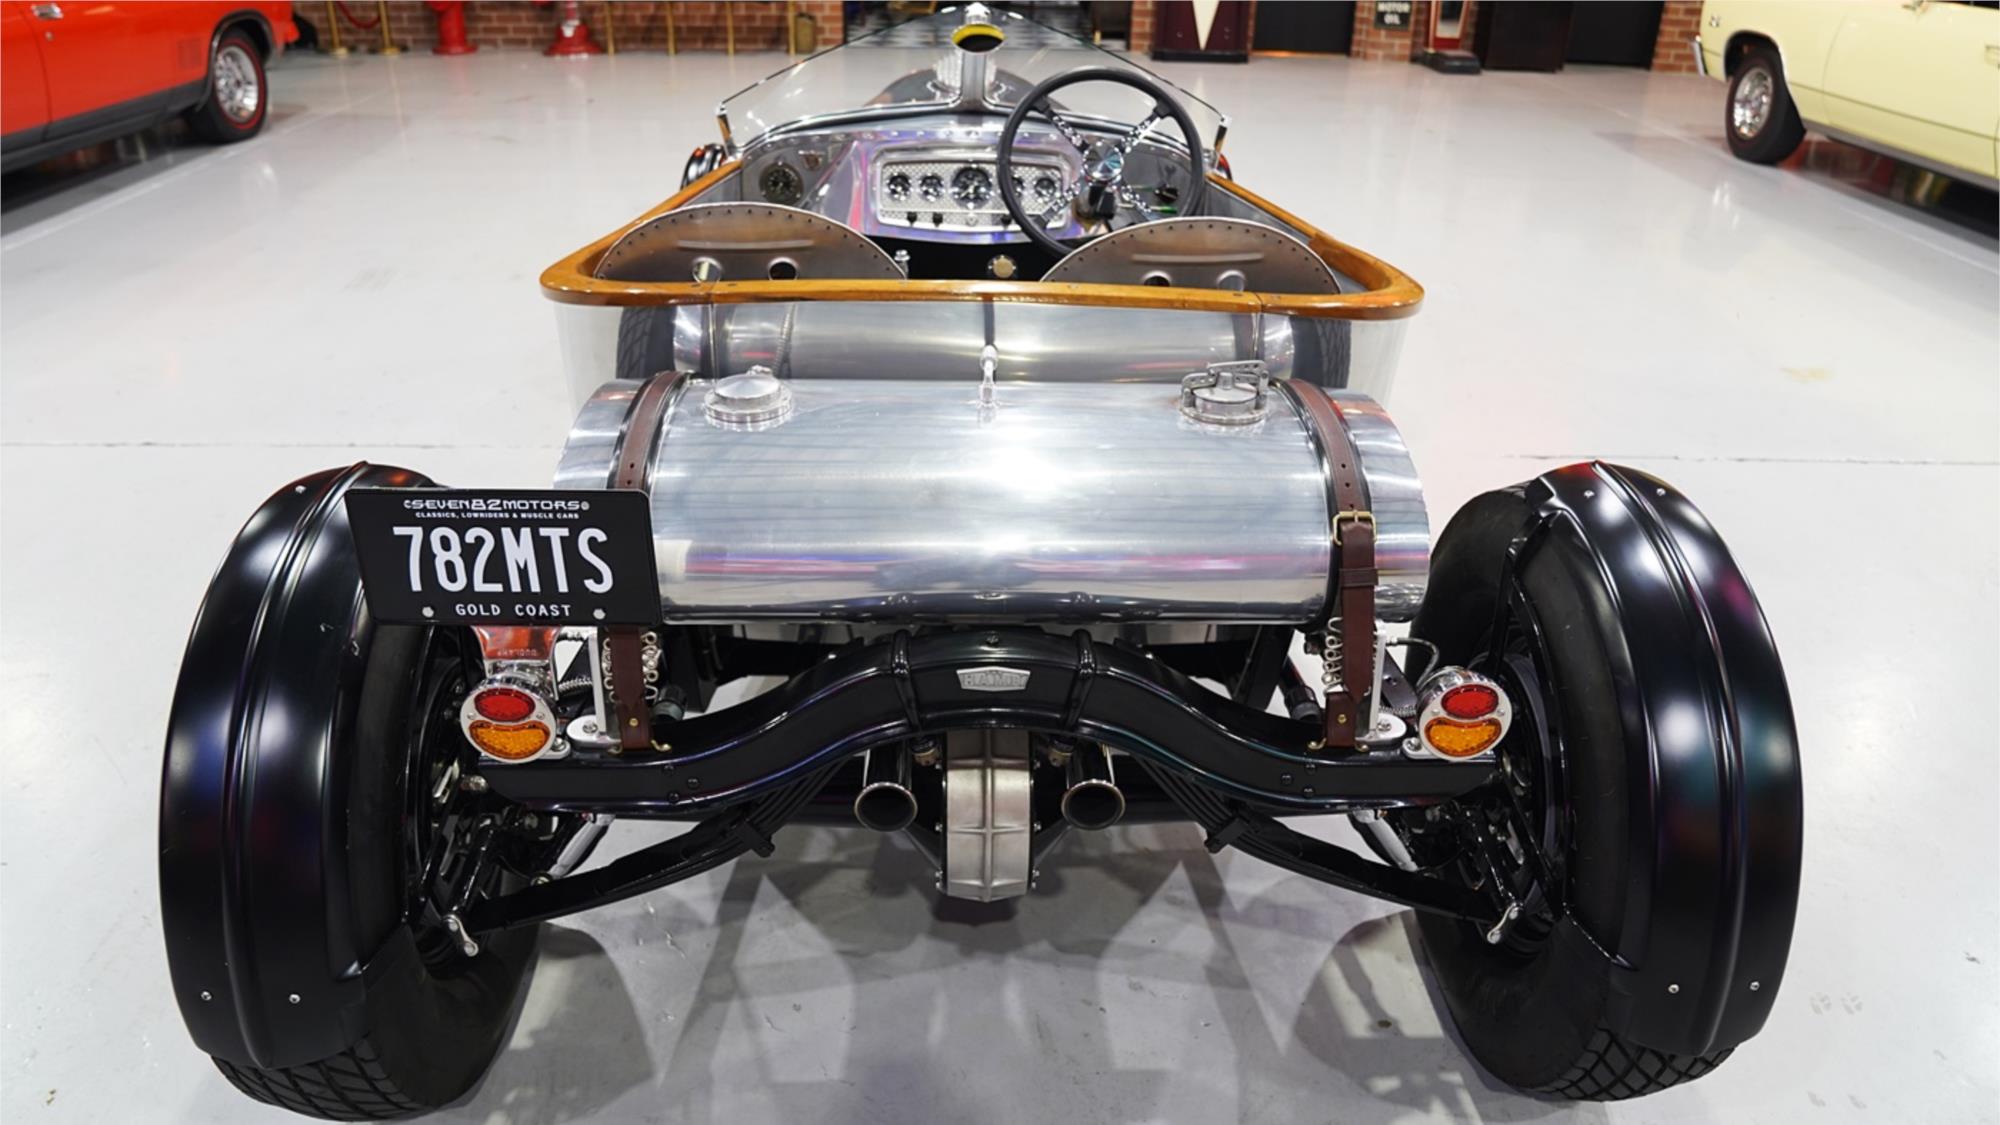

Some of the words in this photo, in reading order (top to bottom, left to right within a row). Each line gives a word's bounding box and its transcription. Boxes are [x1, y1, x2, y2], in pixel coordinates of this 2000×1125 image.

[392, 526, 614, 593] 782MTS
[455, 603, 501, 616] GOLD
[514, 603, 571, 617] COAST
